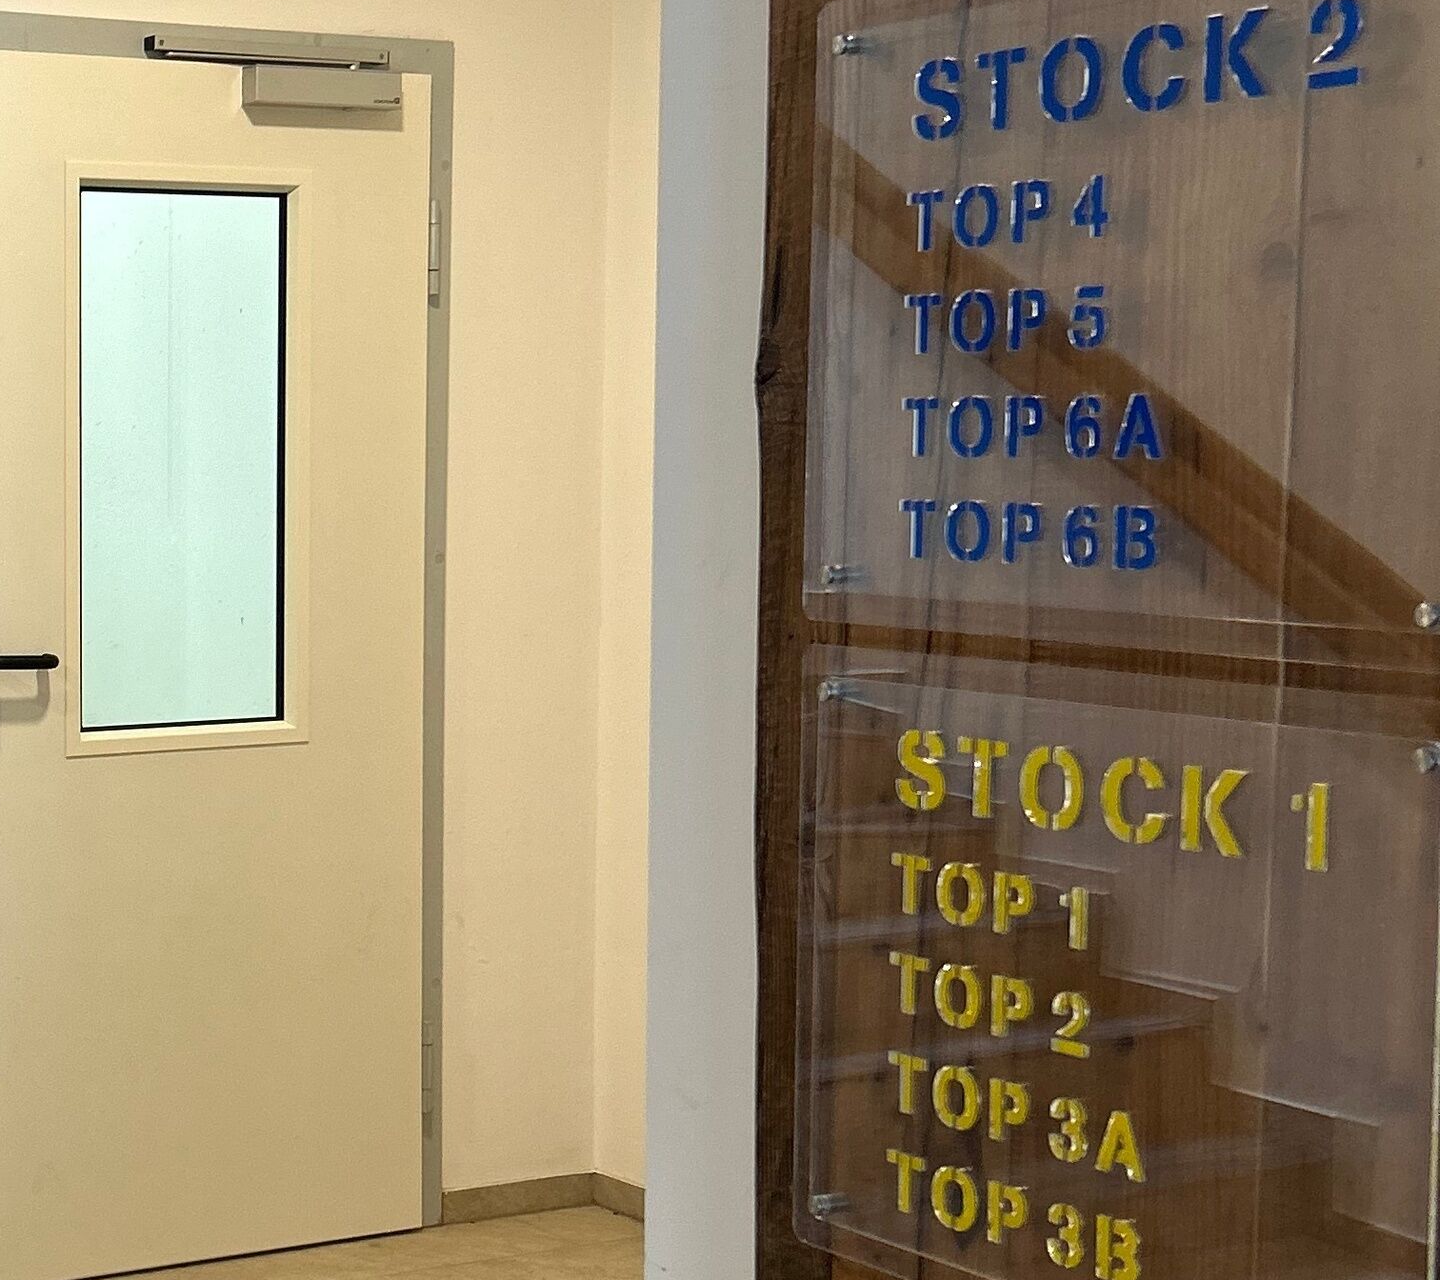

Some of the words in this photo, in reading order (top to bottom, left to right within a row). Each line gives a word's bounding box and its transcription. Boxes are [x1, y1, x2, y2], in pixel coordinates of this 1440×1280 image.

[911, 5, 1269, 140] STOCK
[906, 178, 1051, 252] TOP
[1072, 175, 1109, 238] 4
[904, 287, 1049, 355] TOP
[1066, 284, 1108, 350] 5
[901, 394, 1045, 459] TOP
[1064, 393, 1165, 460] 6A
[899, 498, 1043, 563] TOP
[1061, 504, 1158, 571] 6B
[894, 729, 1251, 858] STOCK
[1290, 782, 1329, 872] 1
[891, 852, 1034, 935] TOP
[1060, 886, 1090, 950] 1
[889, 951, 1032, 1038] TOP
[1050, 991, 1091, 1058] 2
[888, 1051, 1030, 1141] TOP
[1048, 1096, 1146, 1182] 3A
[886, 1149, 1029, 1245] TOP
